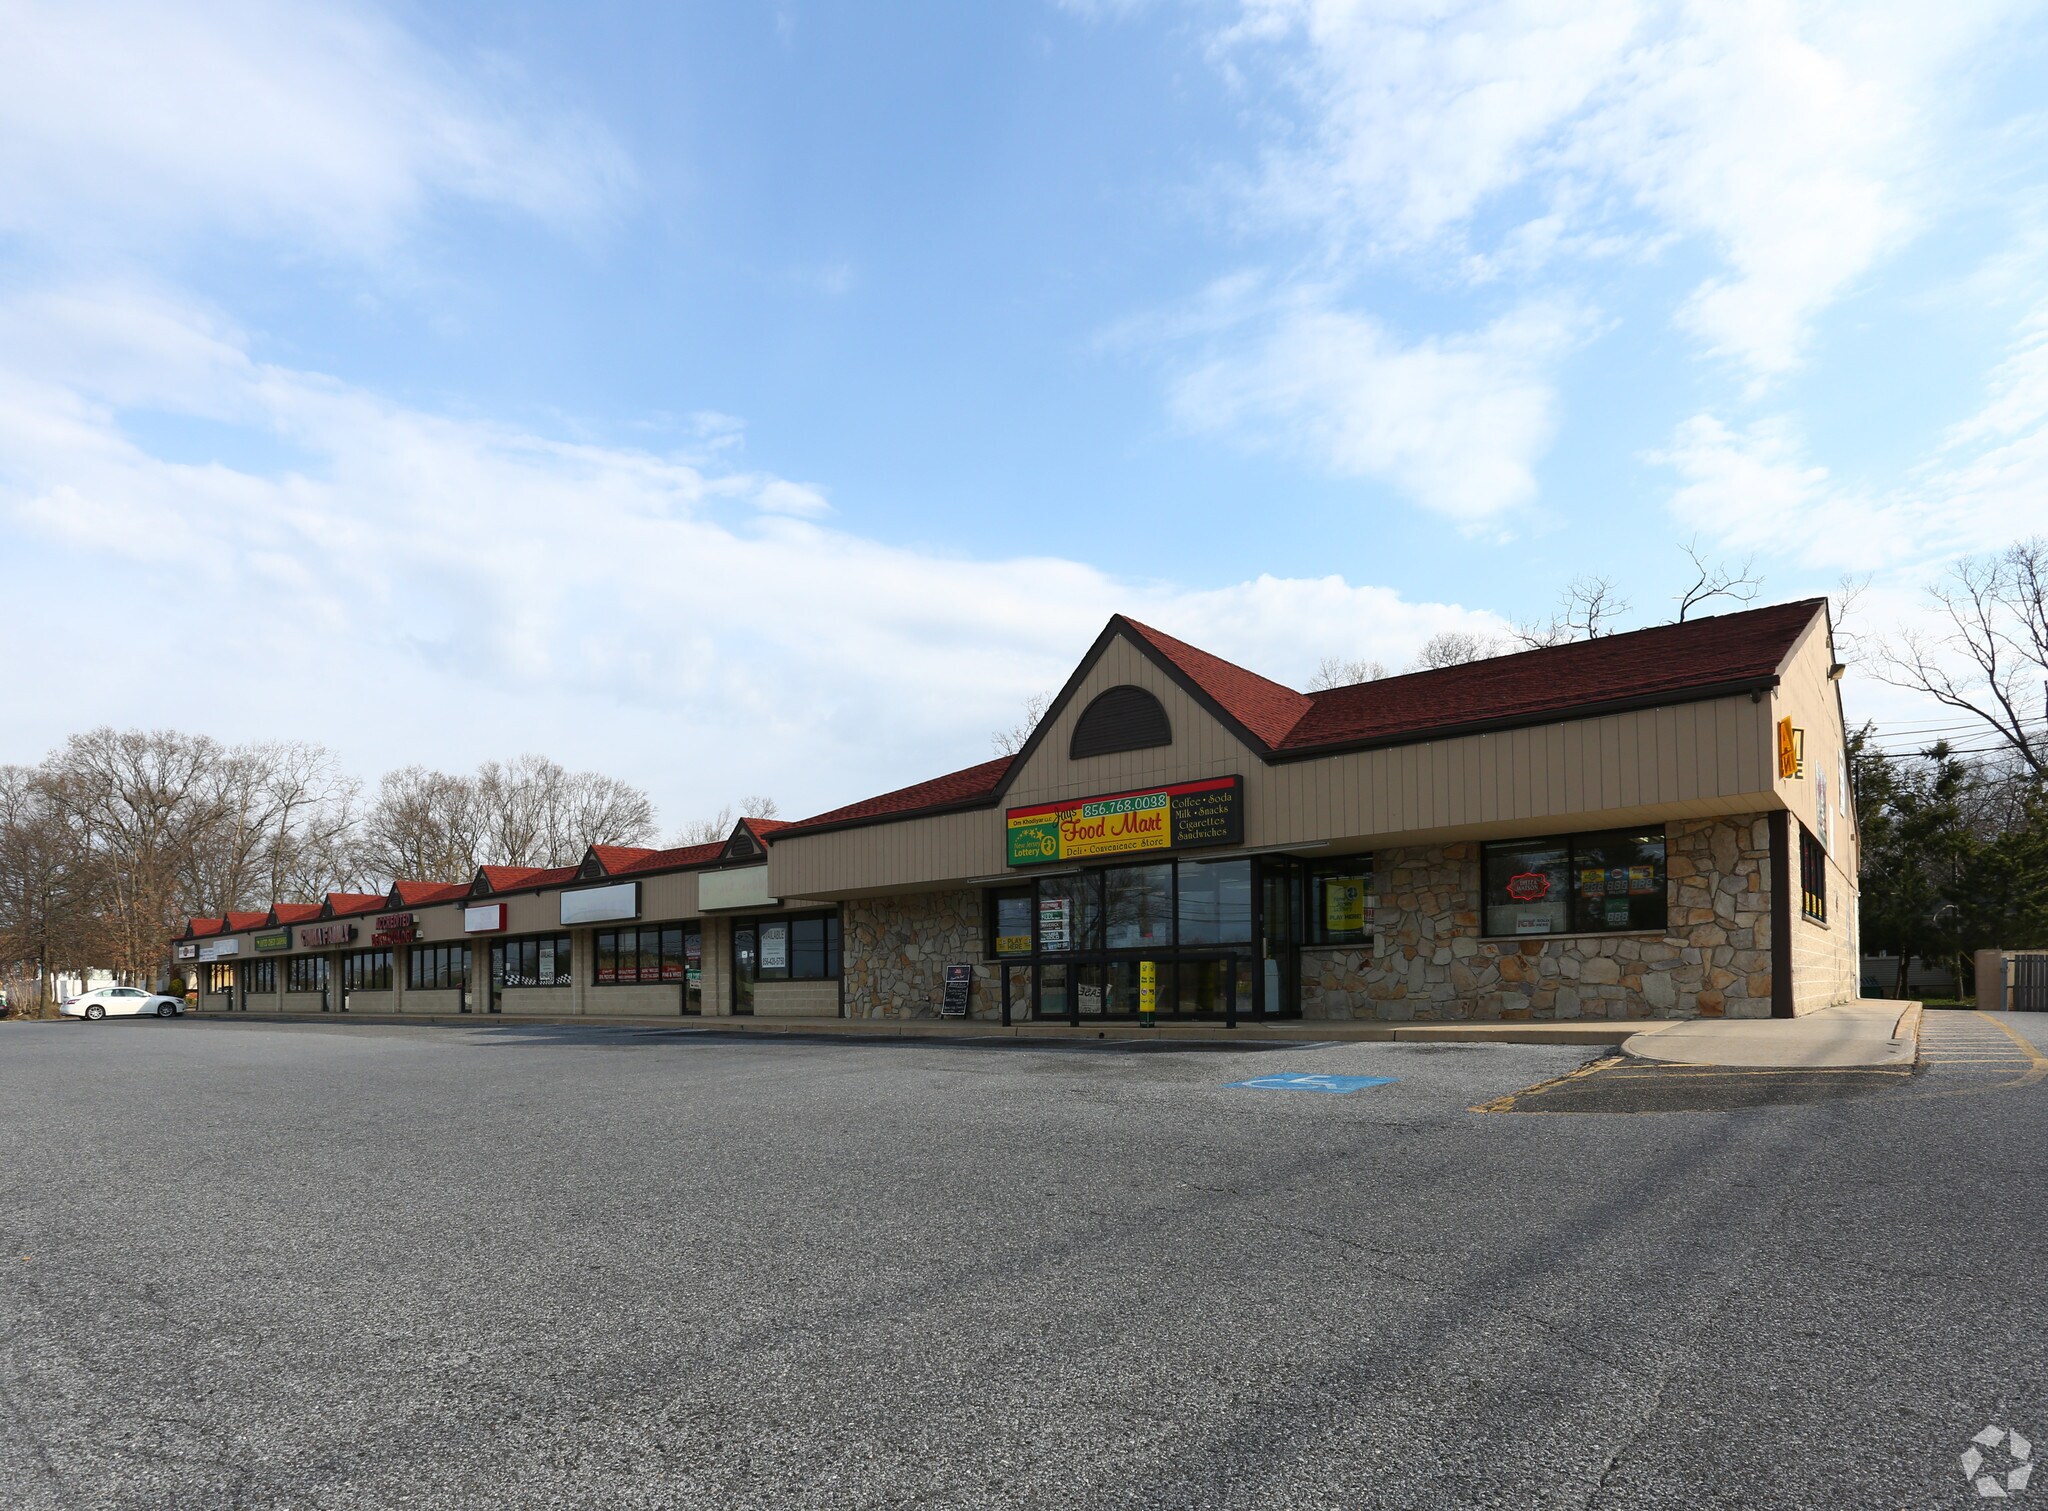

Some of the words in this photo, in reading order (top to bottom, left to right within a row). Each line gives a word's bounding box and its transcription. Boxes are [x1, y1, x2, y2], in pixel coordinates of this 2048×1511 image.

[1171, 797, 1201, 809] Coffee
[1207, 792, 1232, 804] Soda
[1175, 808, 1192, 820] Milk
[1198, 804, 1229, 817] Snacks
[1060, 816, 1106, 842] Food
[1111, 811, 1162, 836] Mart
[1179, 817, 1225, 832] Cigarettes
[1177, 827, 1228, 841] Sandwiches
[1014, 848, 1040, 857] Lottery
[1066, 848, 1083, 856] Deli
[1089, 842, 1137, 854] Convenience
[1140, 838, 1164, 847] Store
[1007, 937, 1023, 945] PLAY
